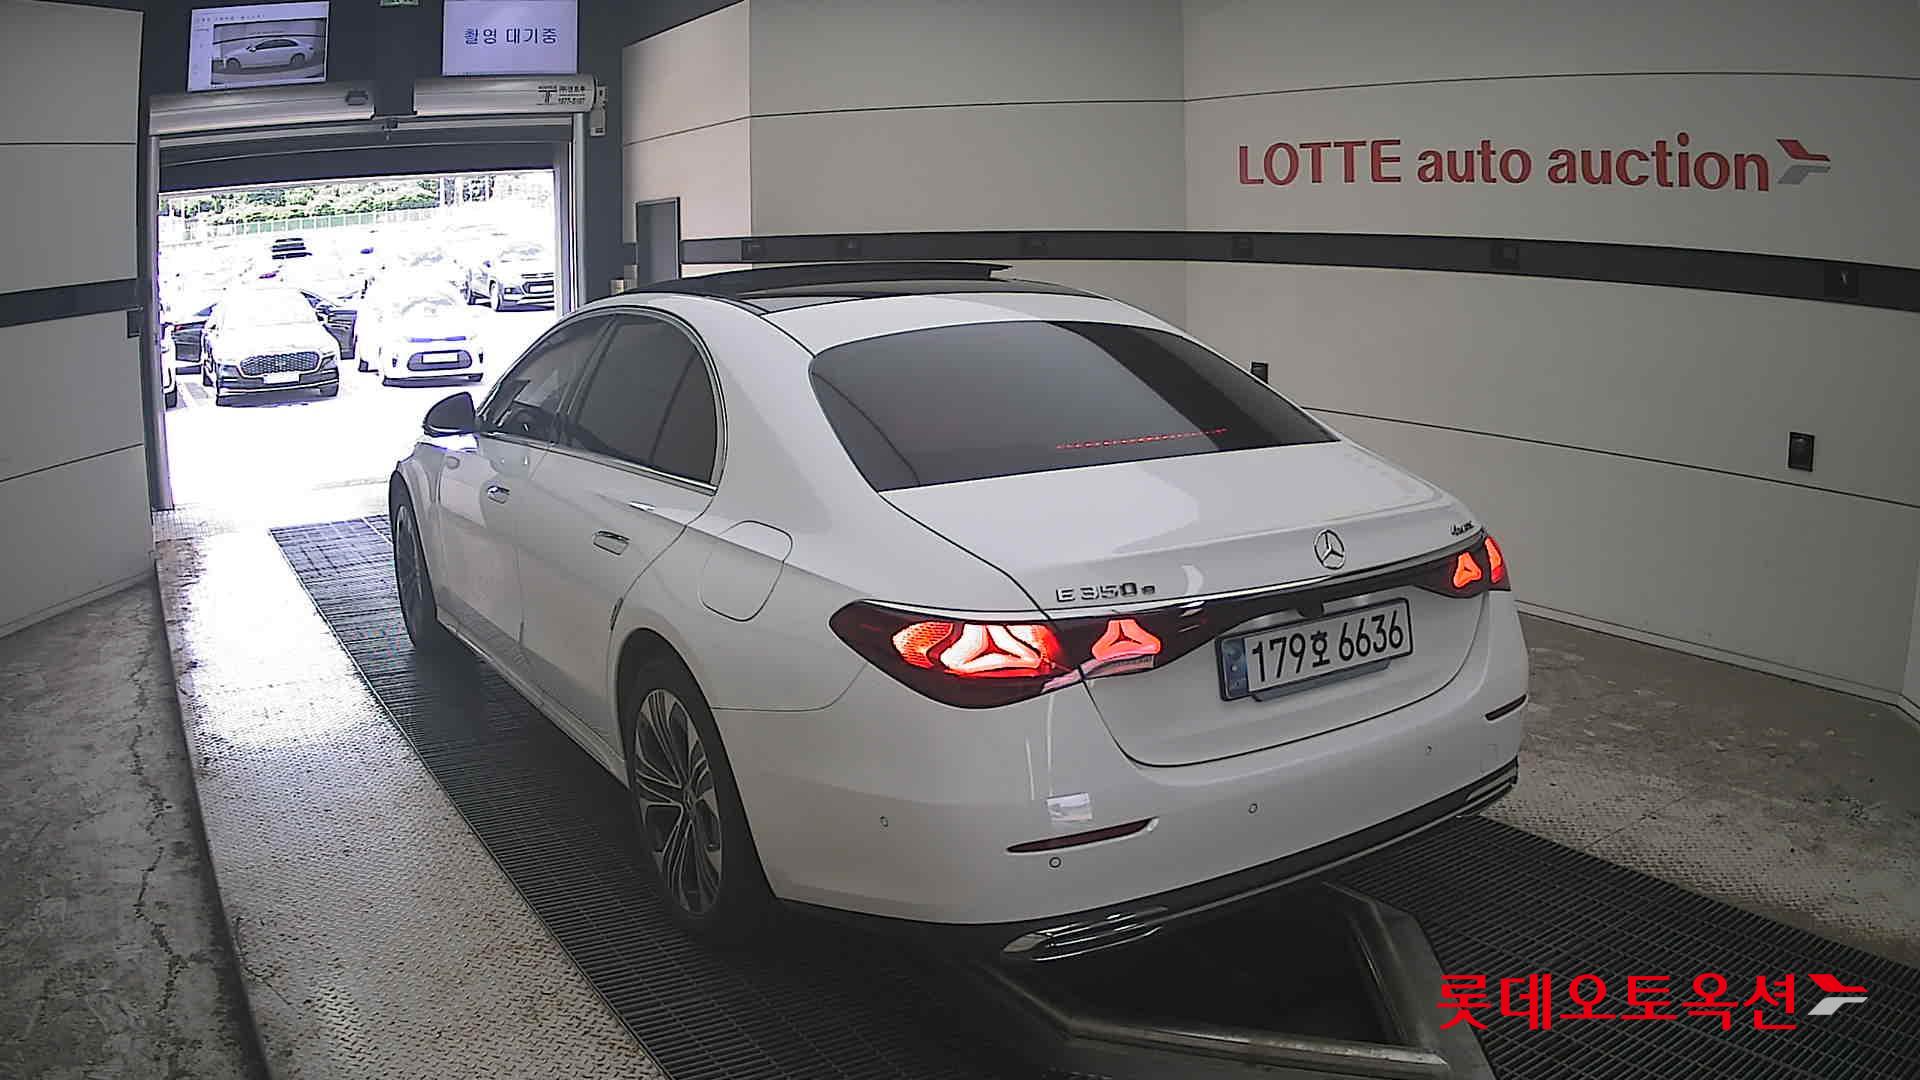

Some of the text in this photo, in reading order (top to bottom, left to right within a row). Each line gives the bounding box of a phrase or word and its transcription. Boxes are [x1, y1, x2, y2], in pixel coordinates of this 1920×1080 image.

[506, 28, 557, 44] 대기중
[1238, 132, 1770, 192] LOTTE auto auction
[1251, 609, 1404, 682] 179호 6636
